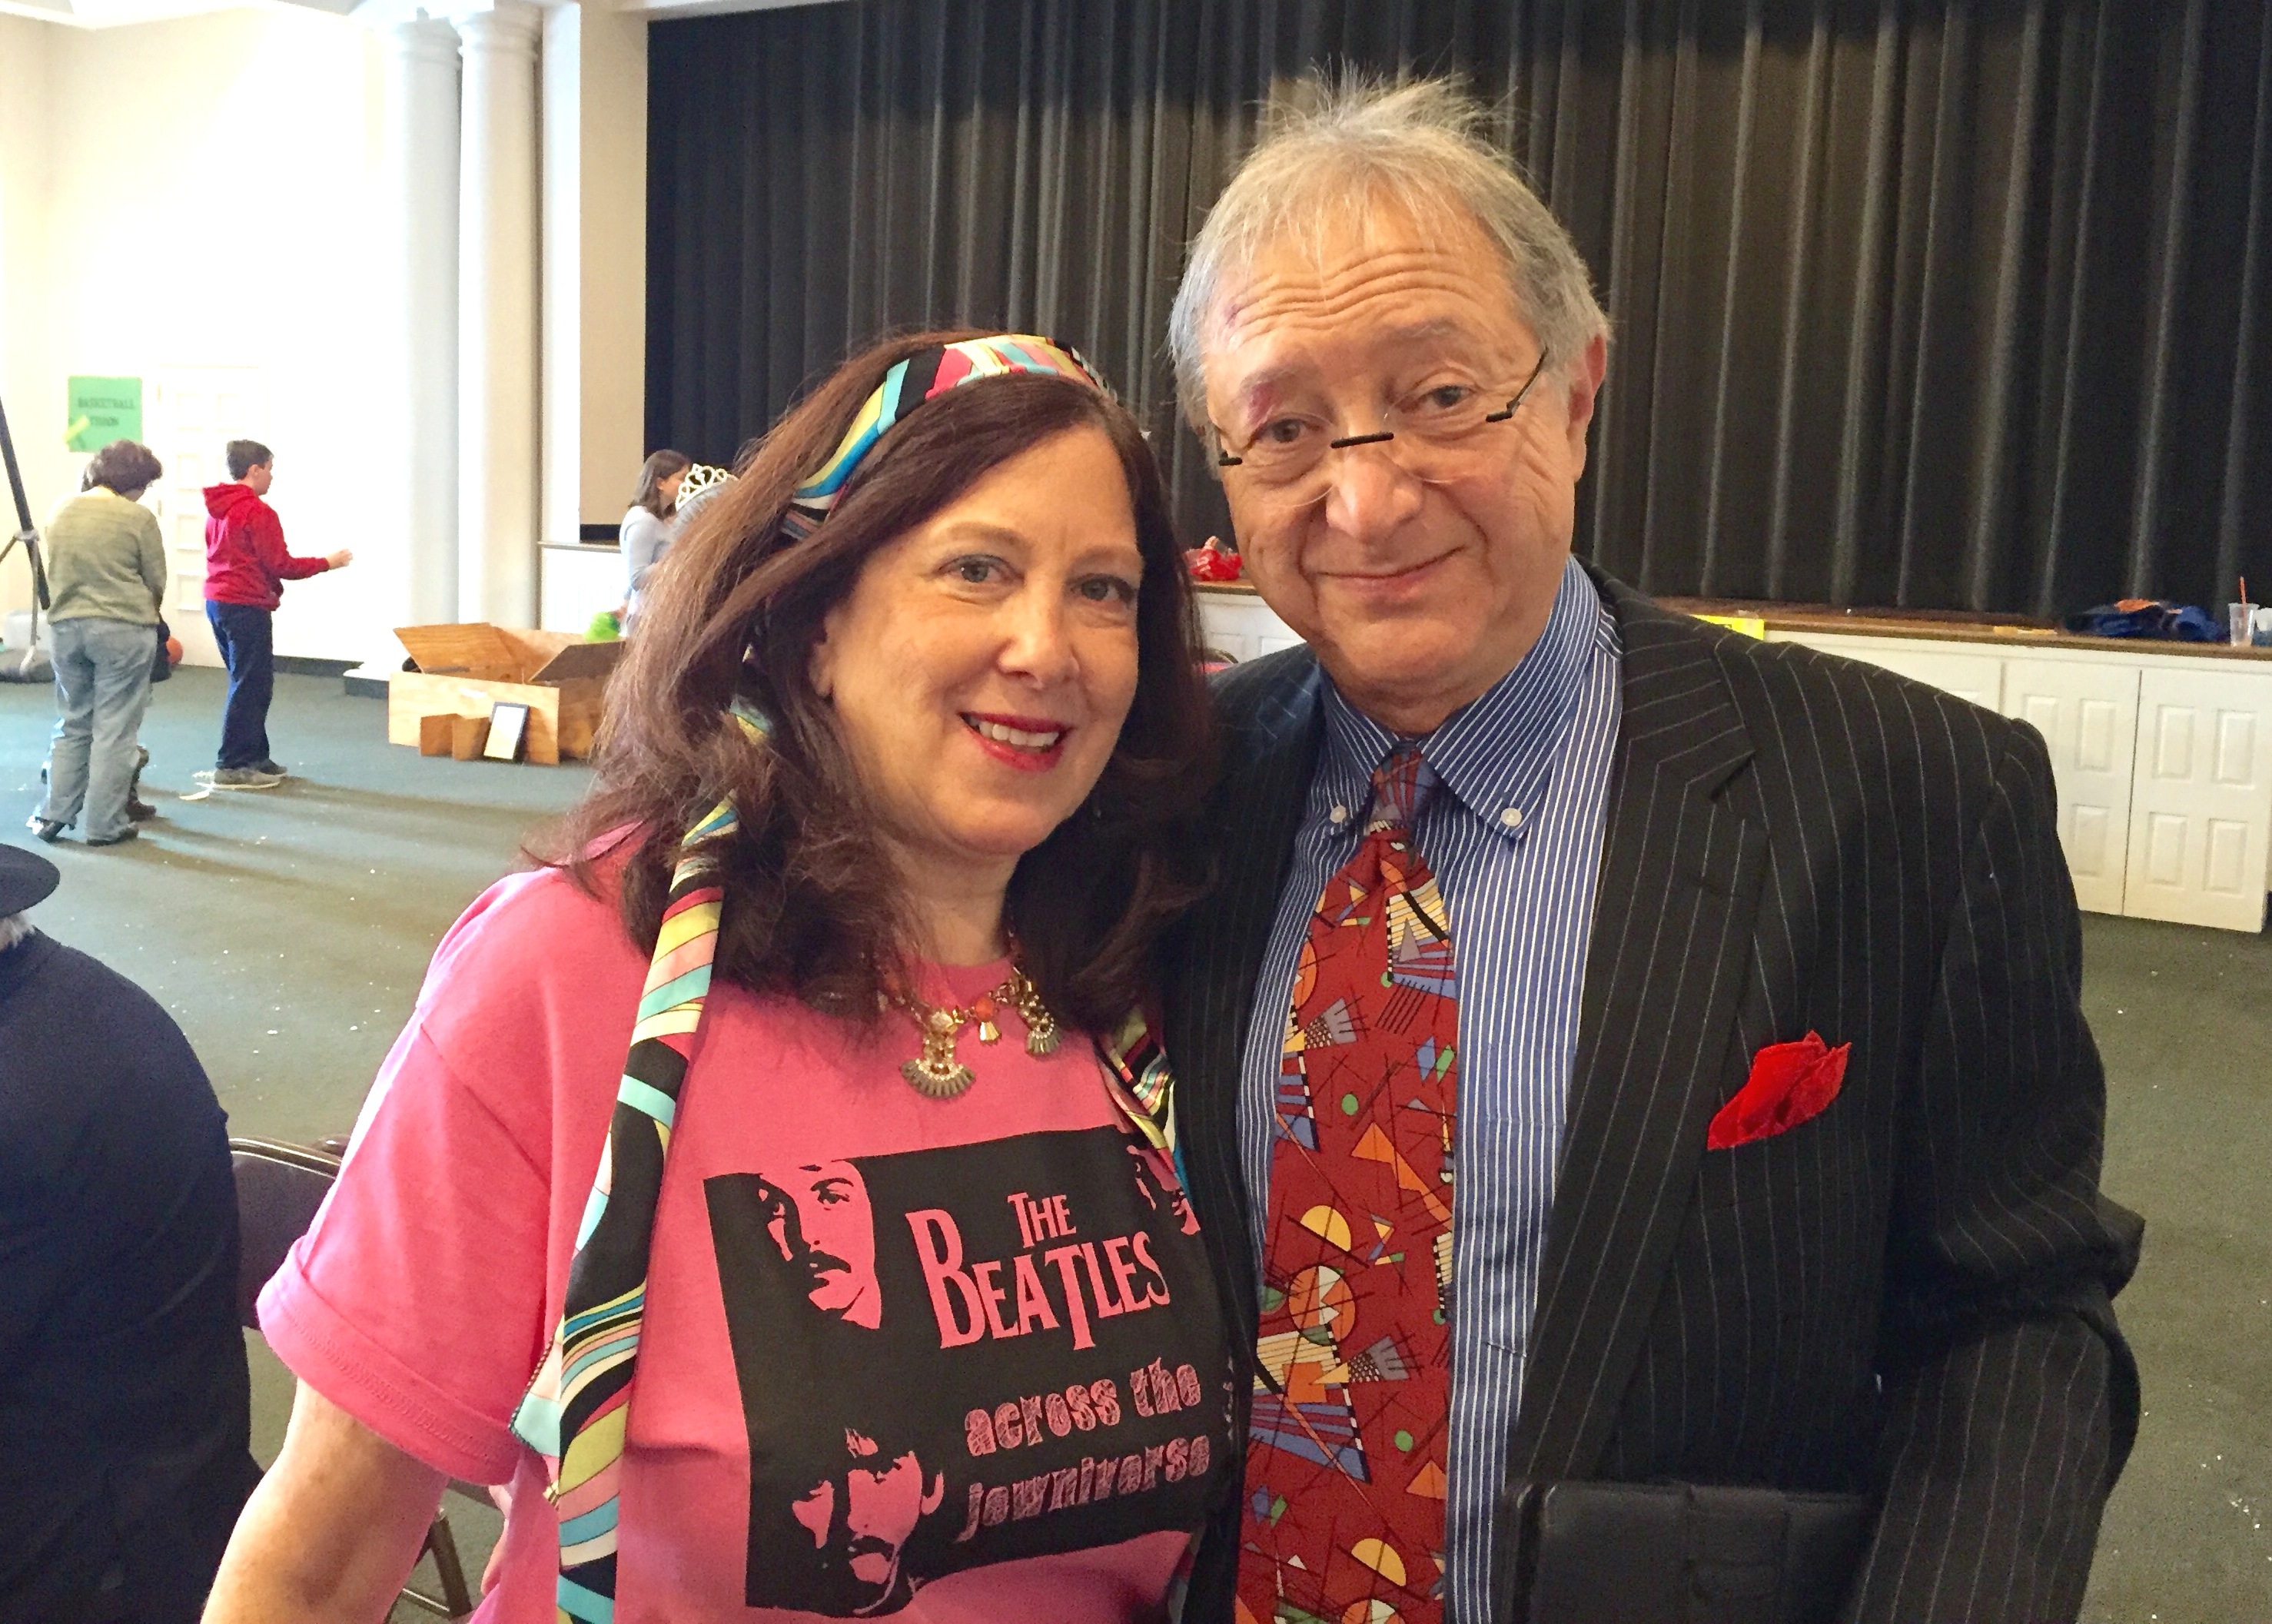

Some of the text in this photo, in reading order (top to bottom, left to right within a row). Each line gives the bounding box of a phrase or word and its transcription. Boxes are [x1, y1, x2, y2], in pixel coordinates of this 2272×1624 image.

[1007, 1191, 1077, 1249] THE
[905, 1208, 1171, 1351] BEATLES
[964, 1357, 1201, 1456] across the
[955, 1434, 1211, 1543] jewniverse
